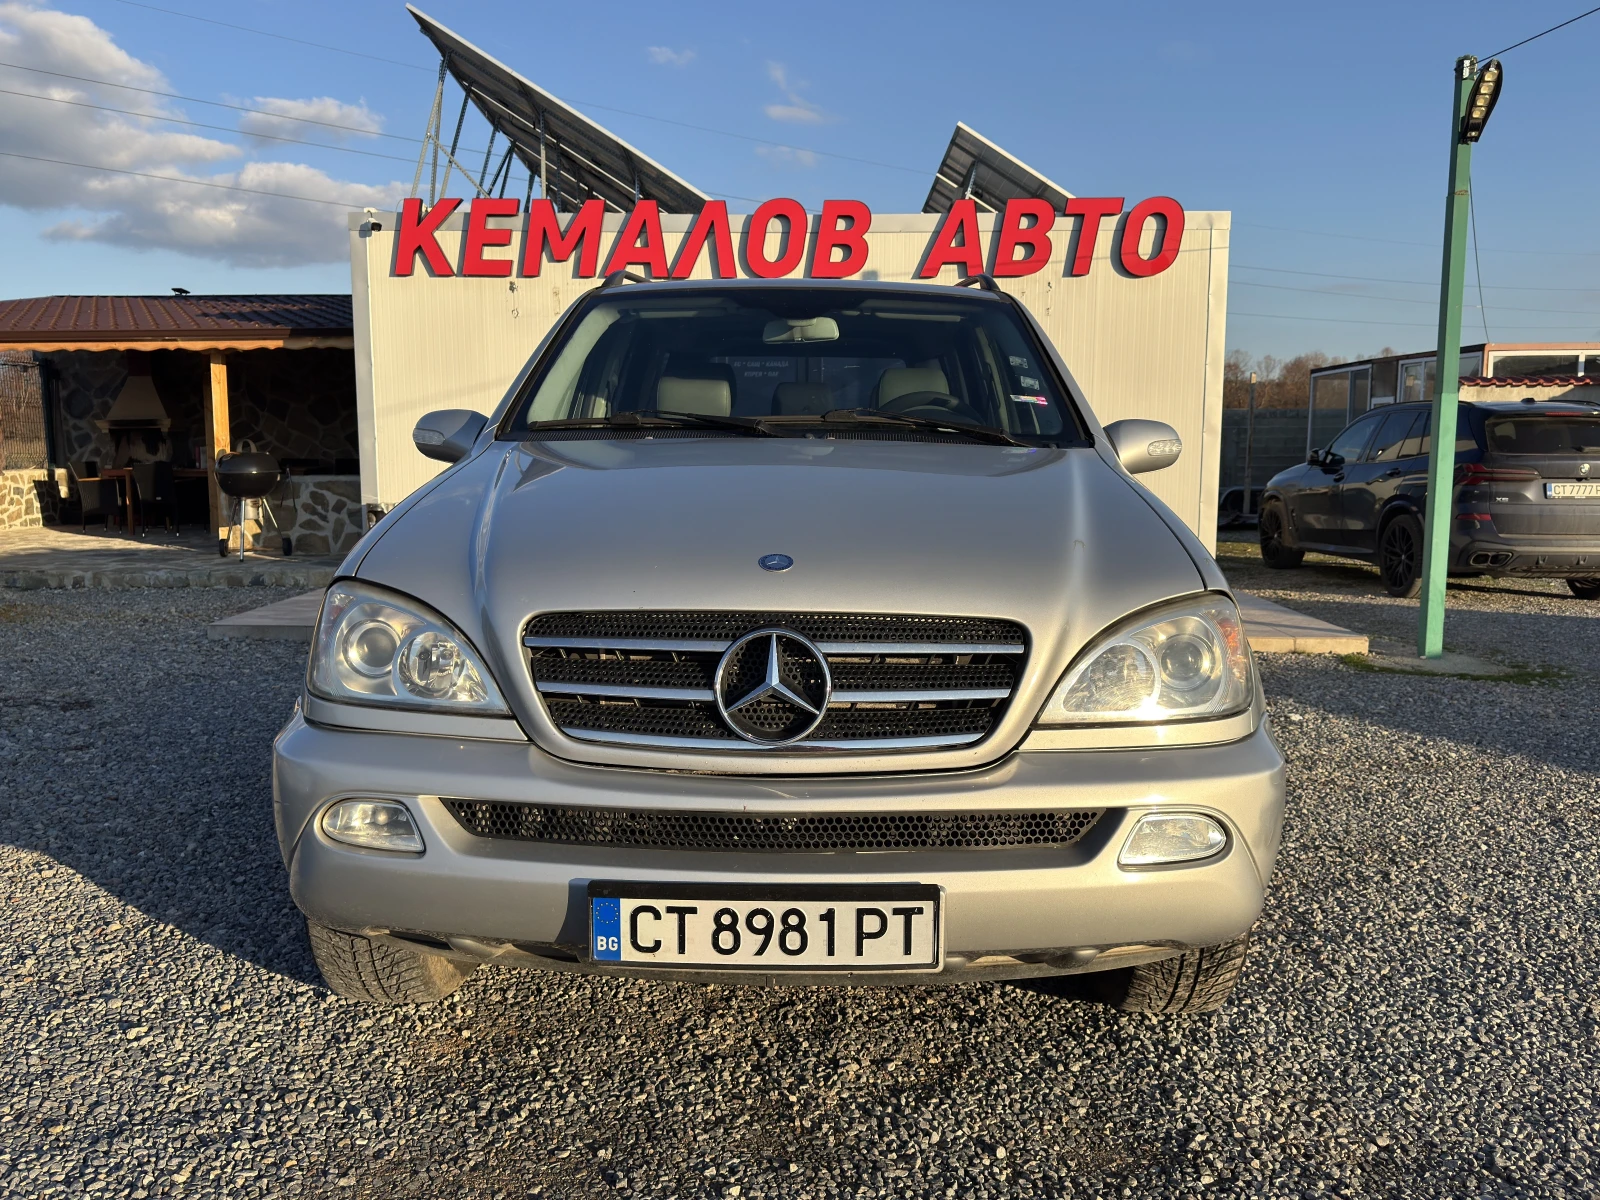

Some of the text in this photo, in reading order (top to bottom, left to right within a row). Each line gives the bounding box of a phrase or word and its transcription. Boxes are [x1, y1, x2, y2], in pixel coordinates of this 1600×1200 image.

[394, 196, 1185, 278] КЕМАЛОВ АВТО
[1553, 484, 1567, 495] CT
[1569, 484, 1594, 495] 7777
[596, 935, 619, 951] BG
[629, 904, 924, 957] CT 8981 PT
